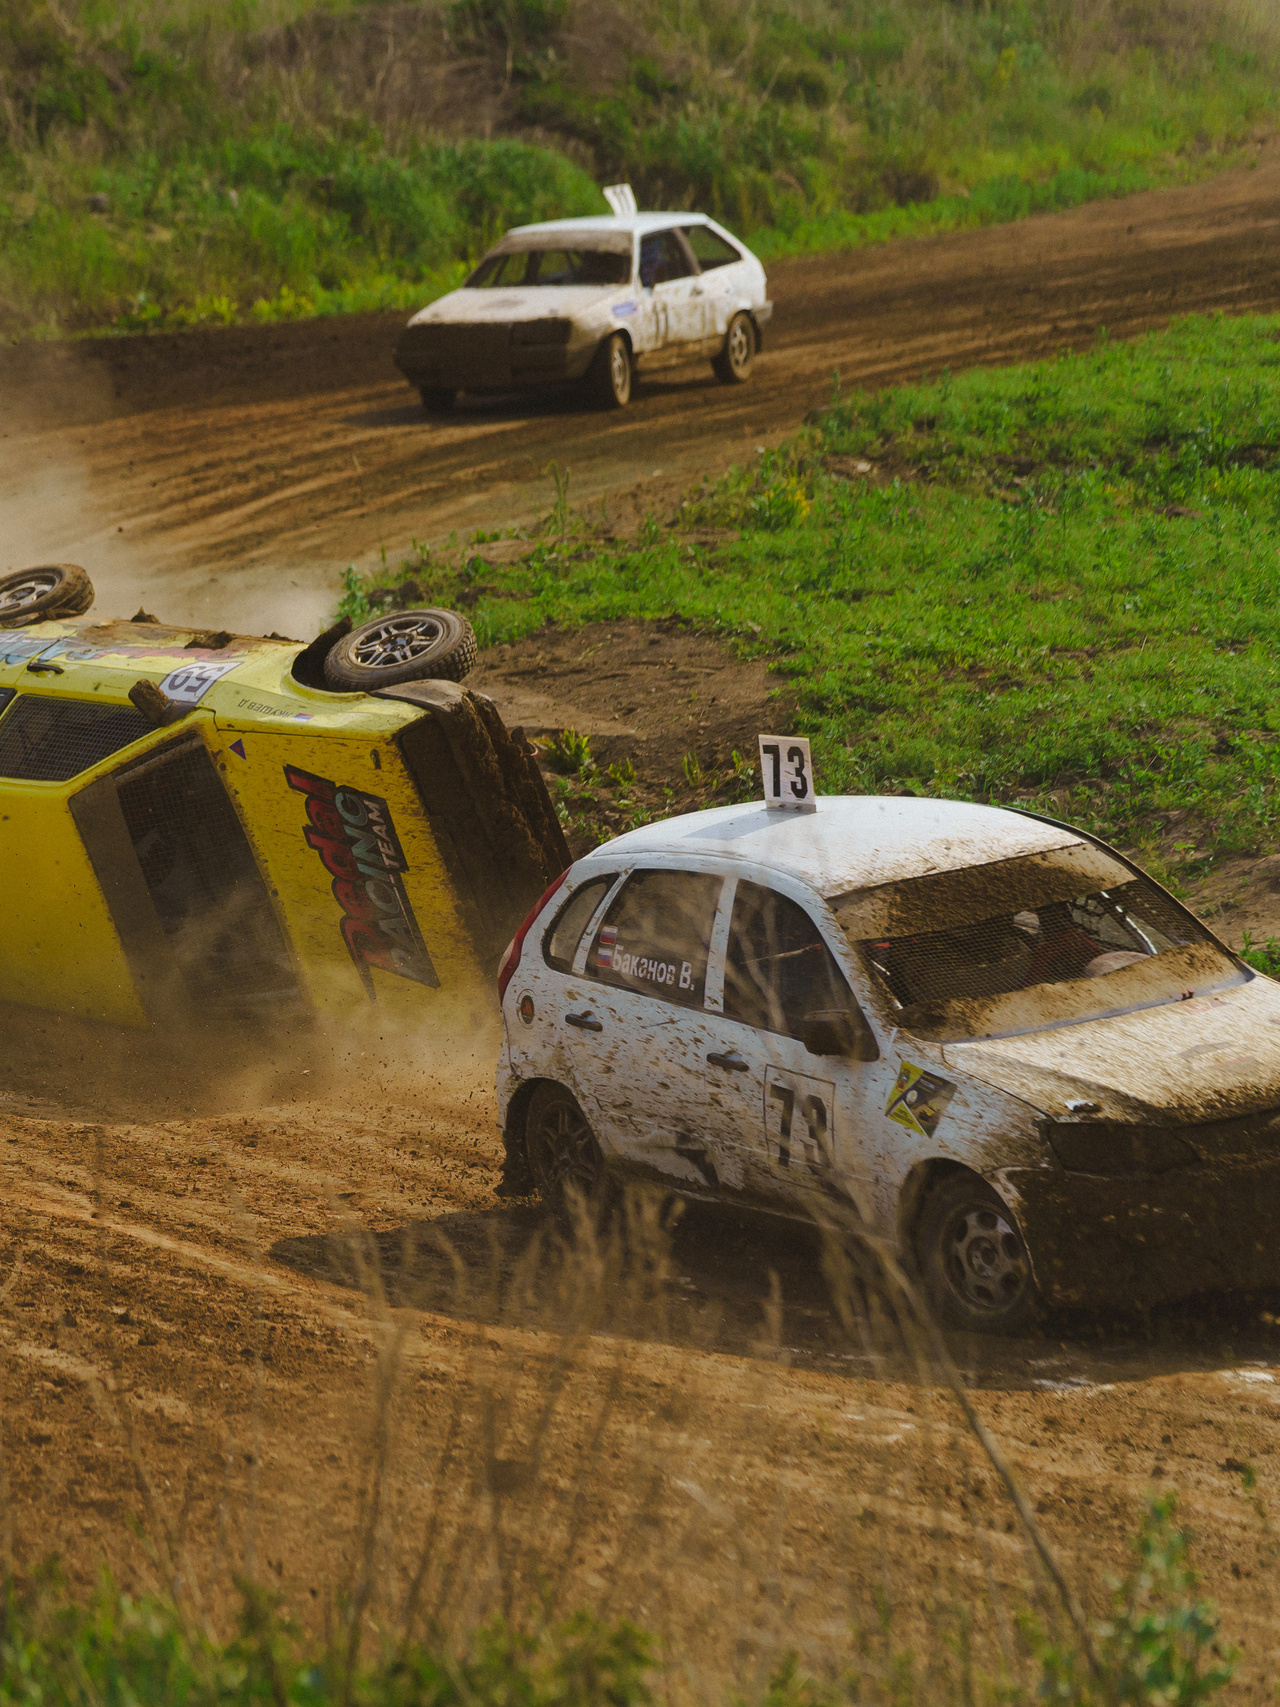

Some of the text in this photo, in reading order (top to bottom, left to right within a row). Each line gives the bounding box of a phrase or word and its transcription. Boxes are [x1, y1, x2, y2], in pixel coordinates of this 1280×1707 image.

[168, 666, 225, 693] 59
[762, 745, 808, 798] 73
[363, 799, 401, 869] TEAM
[335, 791, 428, 983] RACING
[612, 944, 695, 991] Баканов В.
[770, 1084, 828, 1176] 73
